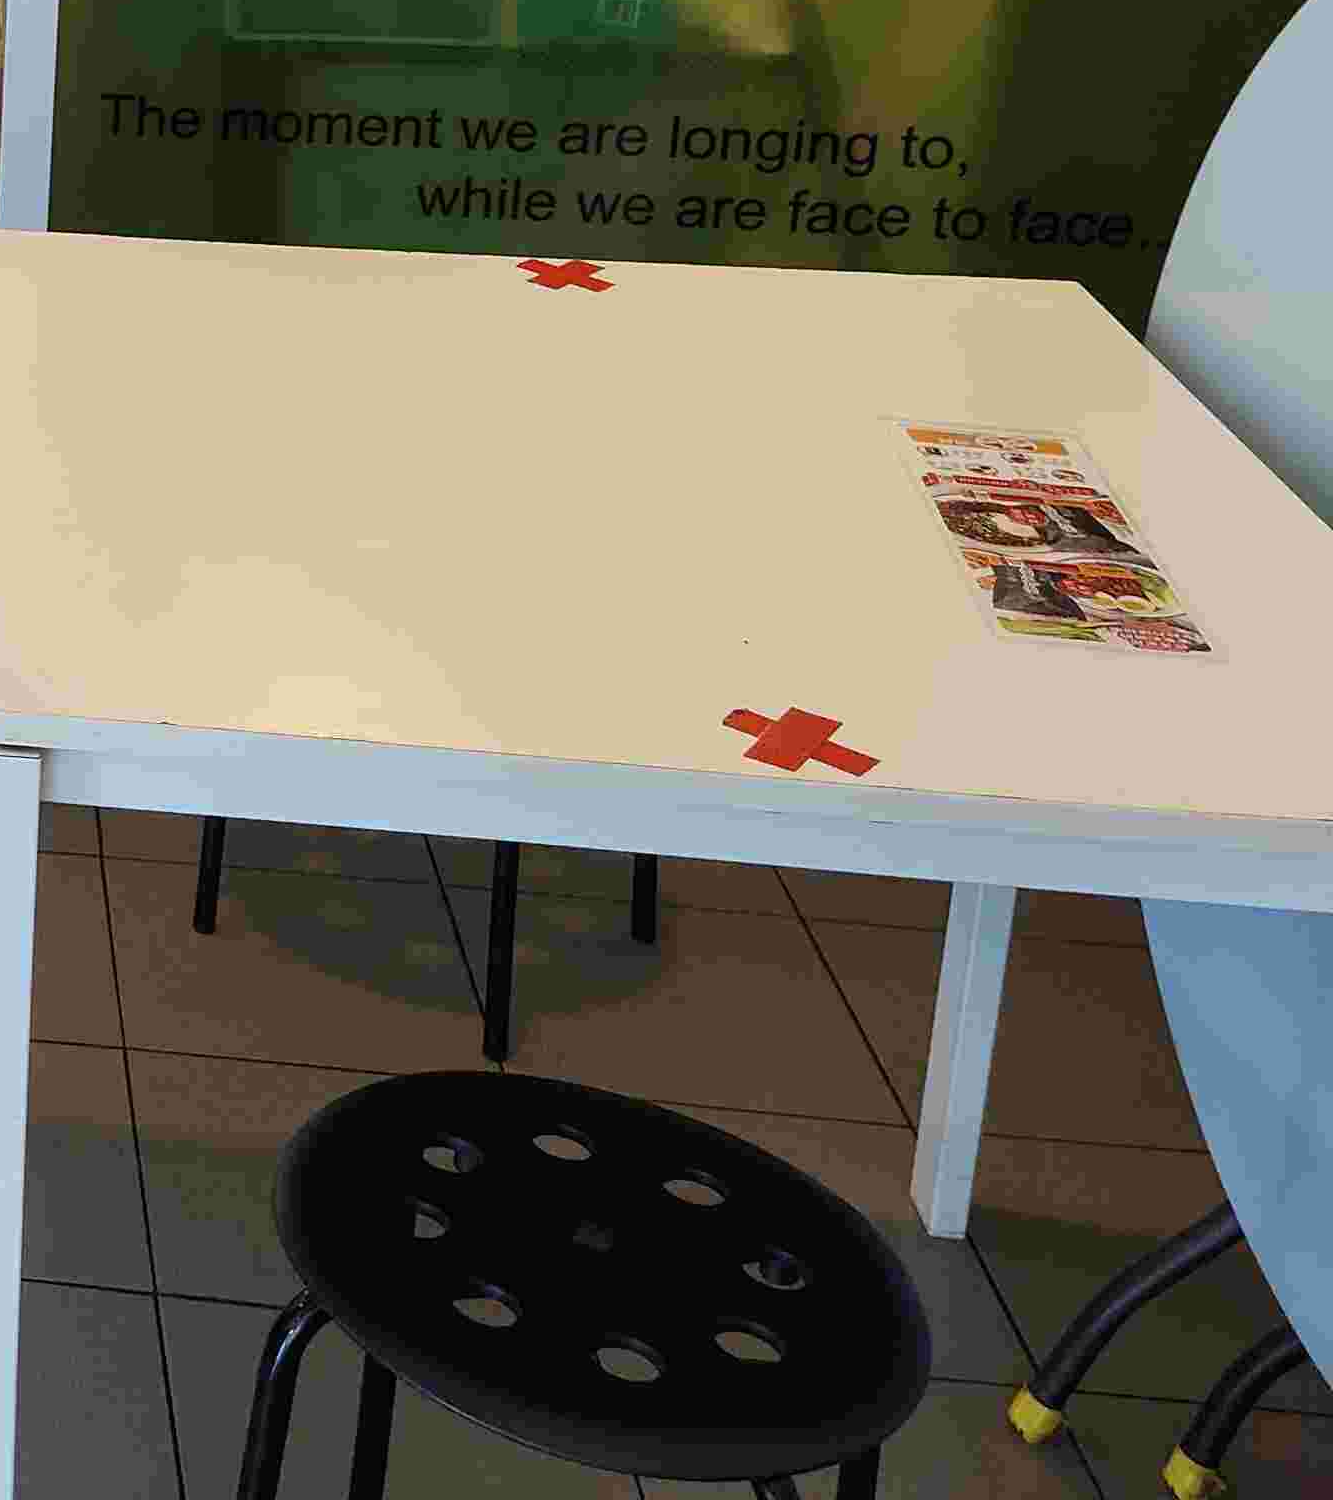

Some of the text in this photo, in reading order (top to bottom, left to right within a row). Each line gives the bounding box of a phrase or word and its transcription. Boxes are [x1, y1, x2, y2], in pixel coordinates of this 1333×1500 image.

[99, 91, 969, 178] The moment we are longing to,
[416, 179, 557, 222] while
[576, 188, 655, 229] we
[675, 194, 768, 232] are
[787, 190, 911, 239] face
[933, 196, 987, 244] to
